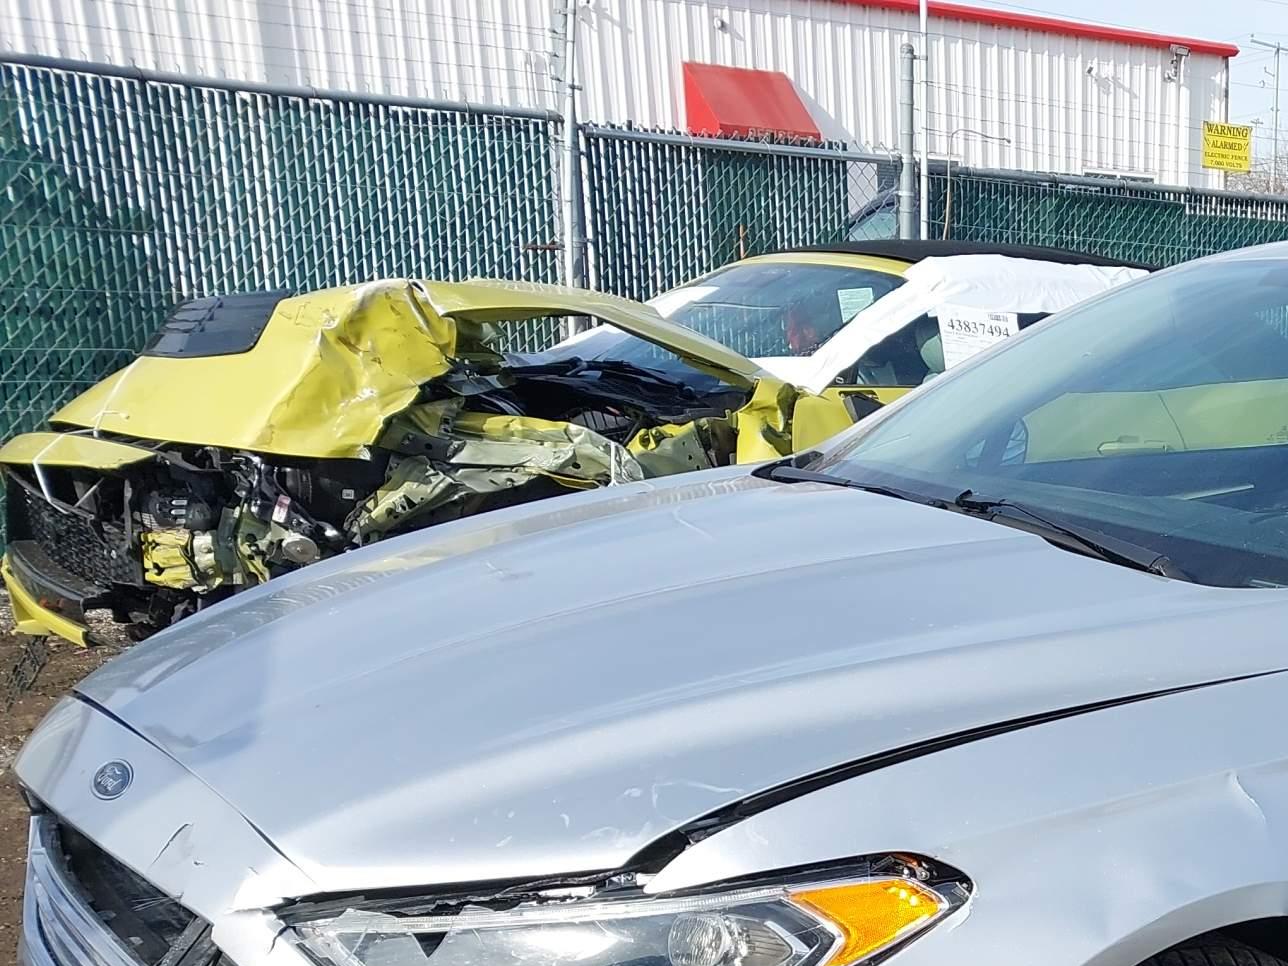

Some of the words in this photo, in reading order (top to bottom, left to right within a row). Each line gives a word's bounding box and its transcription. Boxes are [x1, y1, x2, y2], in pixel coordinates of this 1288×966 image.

[1206, 124, 1248, 138] WARNING
[1211, 139, 1243, 151] ALARMED
[947, 318, 1010, 337] 43837494
